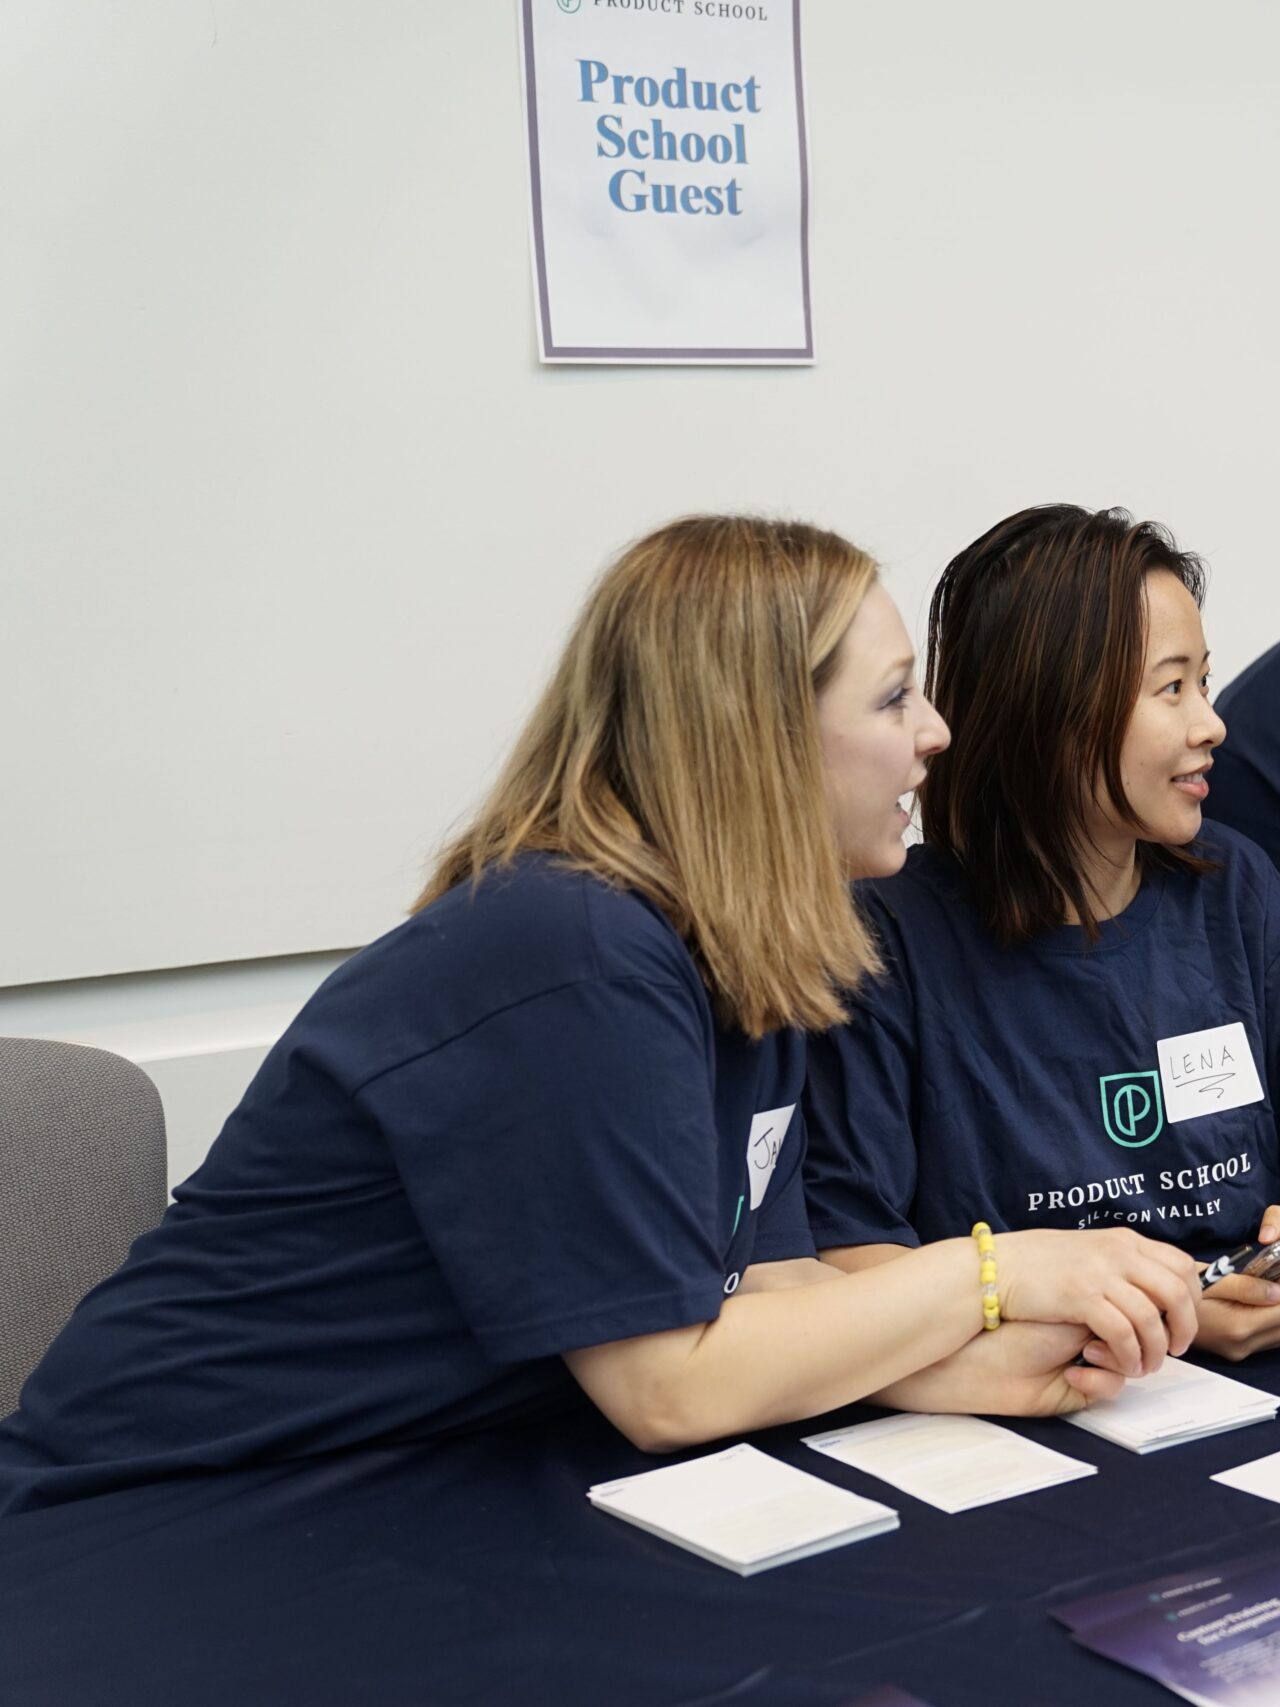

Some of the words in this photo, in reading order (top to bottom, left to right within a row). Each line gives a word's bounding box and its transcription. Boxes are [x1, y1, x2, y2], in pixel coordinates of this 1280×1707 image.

[693, 2, 768, 21] SCHOOL
[574, 58, 762, 114] Product
[596, 114, 749, 165] School
[608, 168, 743, 217] Guest
[1170, 1045, 1235, 1081] LENA
[1027, 1173, 1145, 1212] PRODUCT
[1160, 1152, 1252, 1190] SCHOOL
[1078, 1209, 1151, 1230] SILICON
[1157, 1198, 1222, 1220] VALLEY
